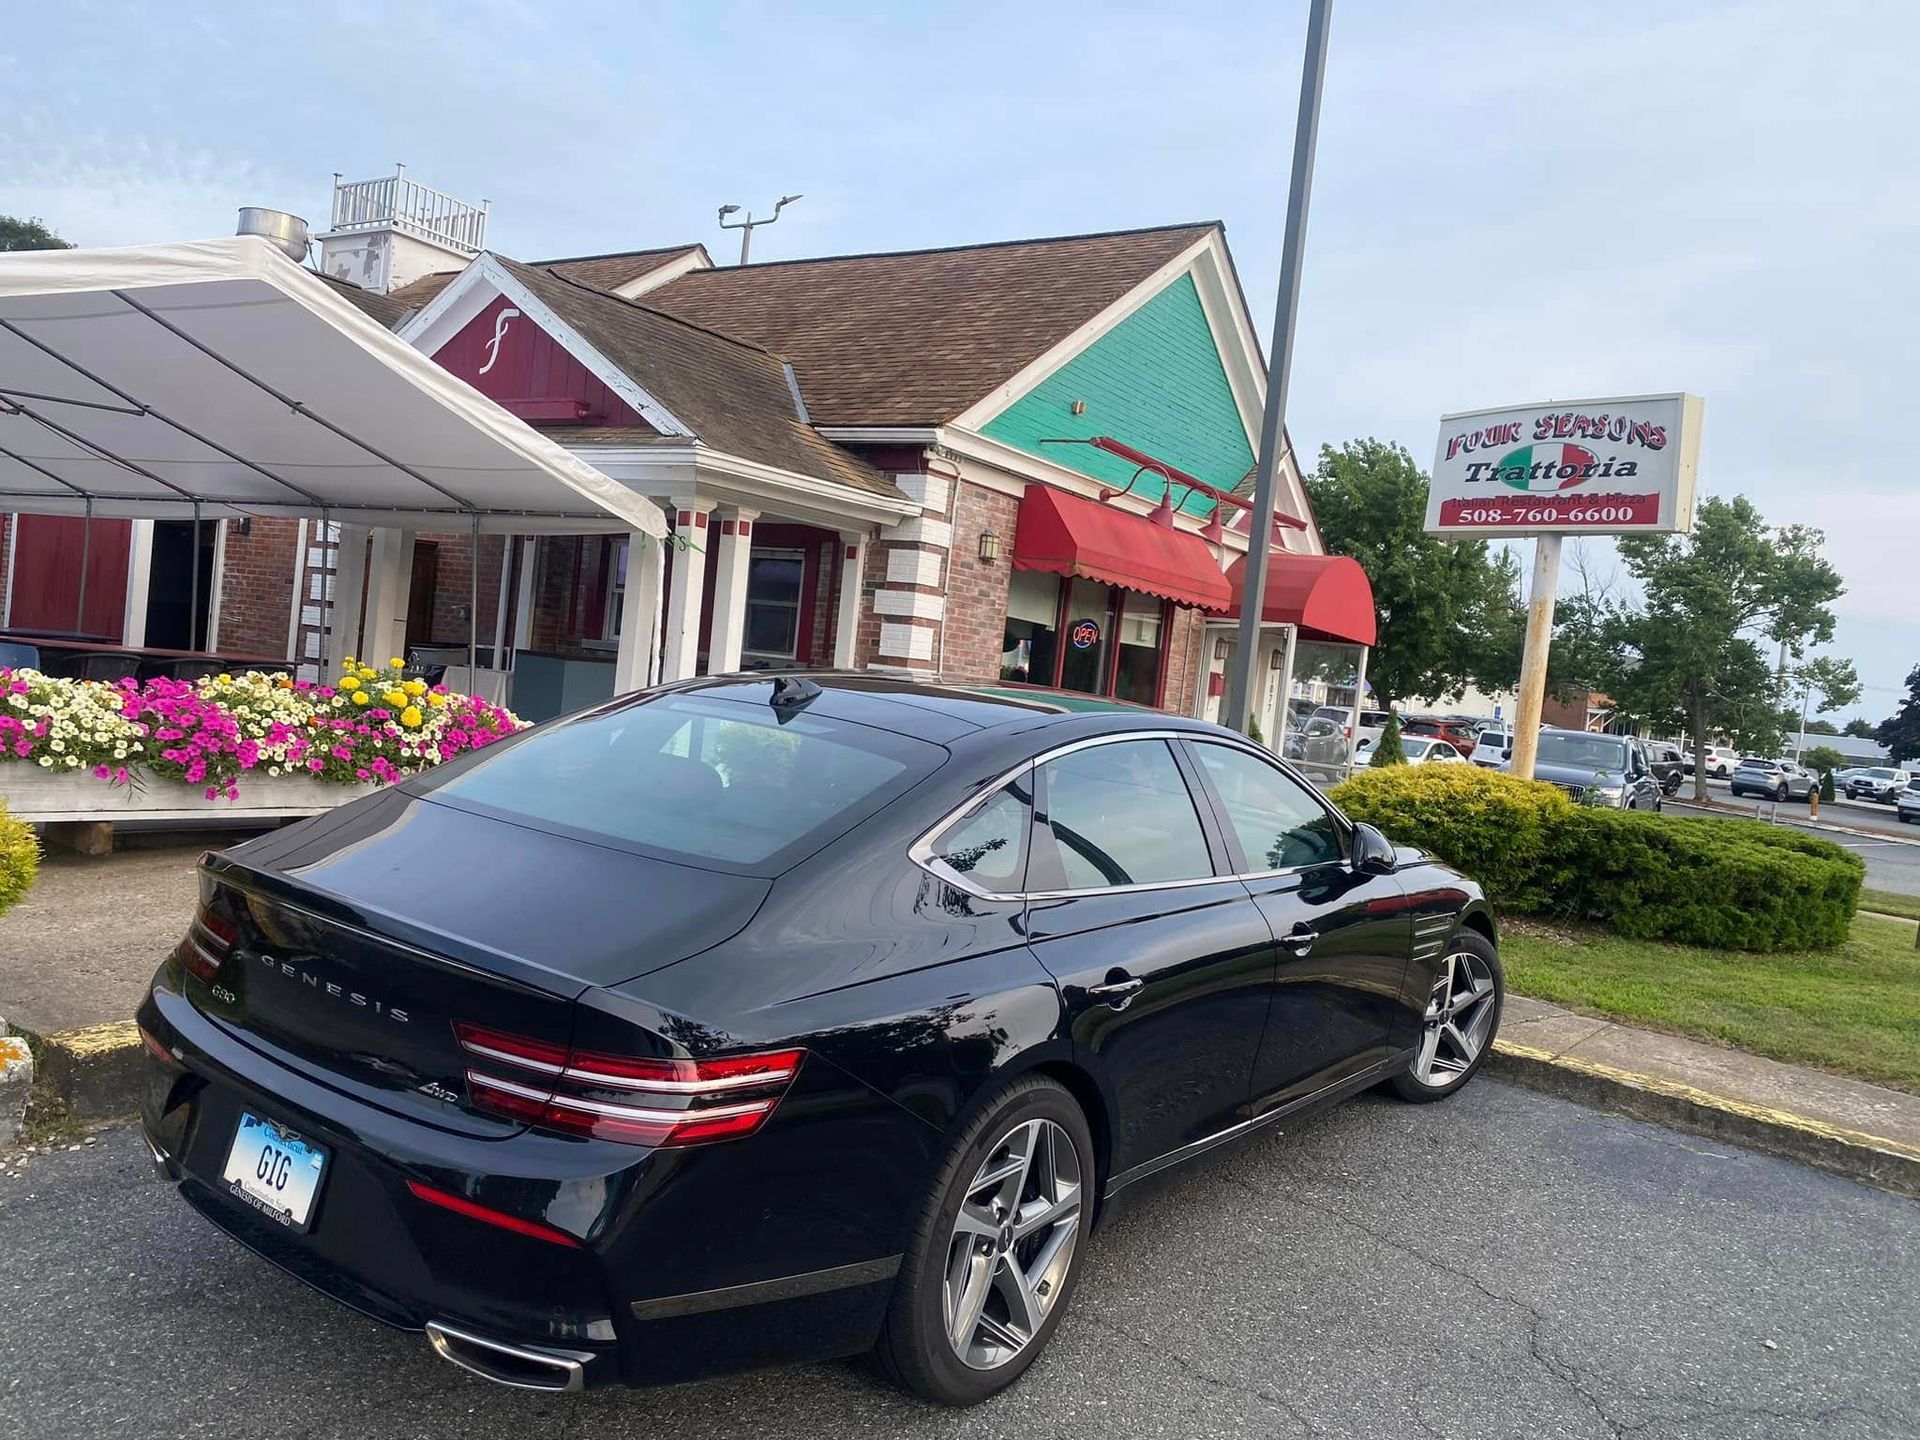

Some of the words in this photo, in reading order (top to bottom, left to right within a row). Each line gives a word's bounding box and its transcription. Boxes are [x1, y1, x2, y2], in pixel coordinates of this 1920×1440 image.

[1445, 422, 1522, 461] FOUR
[1532, 413, 1667, 450] SEASONS
[1464, 456, 1638, 482] Trattoria
[1458, 507, 1634, 523] 508-760-6600
[1503, 494, 1583, 508] Restaurant
[1607, 493, 1646, 505] Pizza
[1073, 625, 1099, 645] OPEN
[260, 954, 409, 1023] GENESIS
[257, 1144, 292, 1191] GIG
[229, 1185, 253, 1205] GENESIS
[252, 1198, 264, 1210] OF
[261, 1204, 292, 1227] MILFORD
